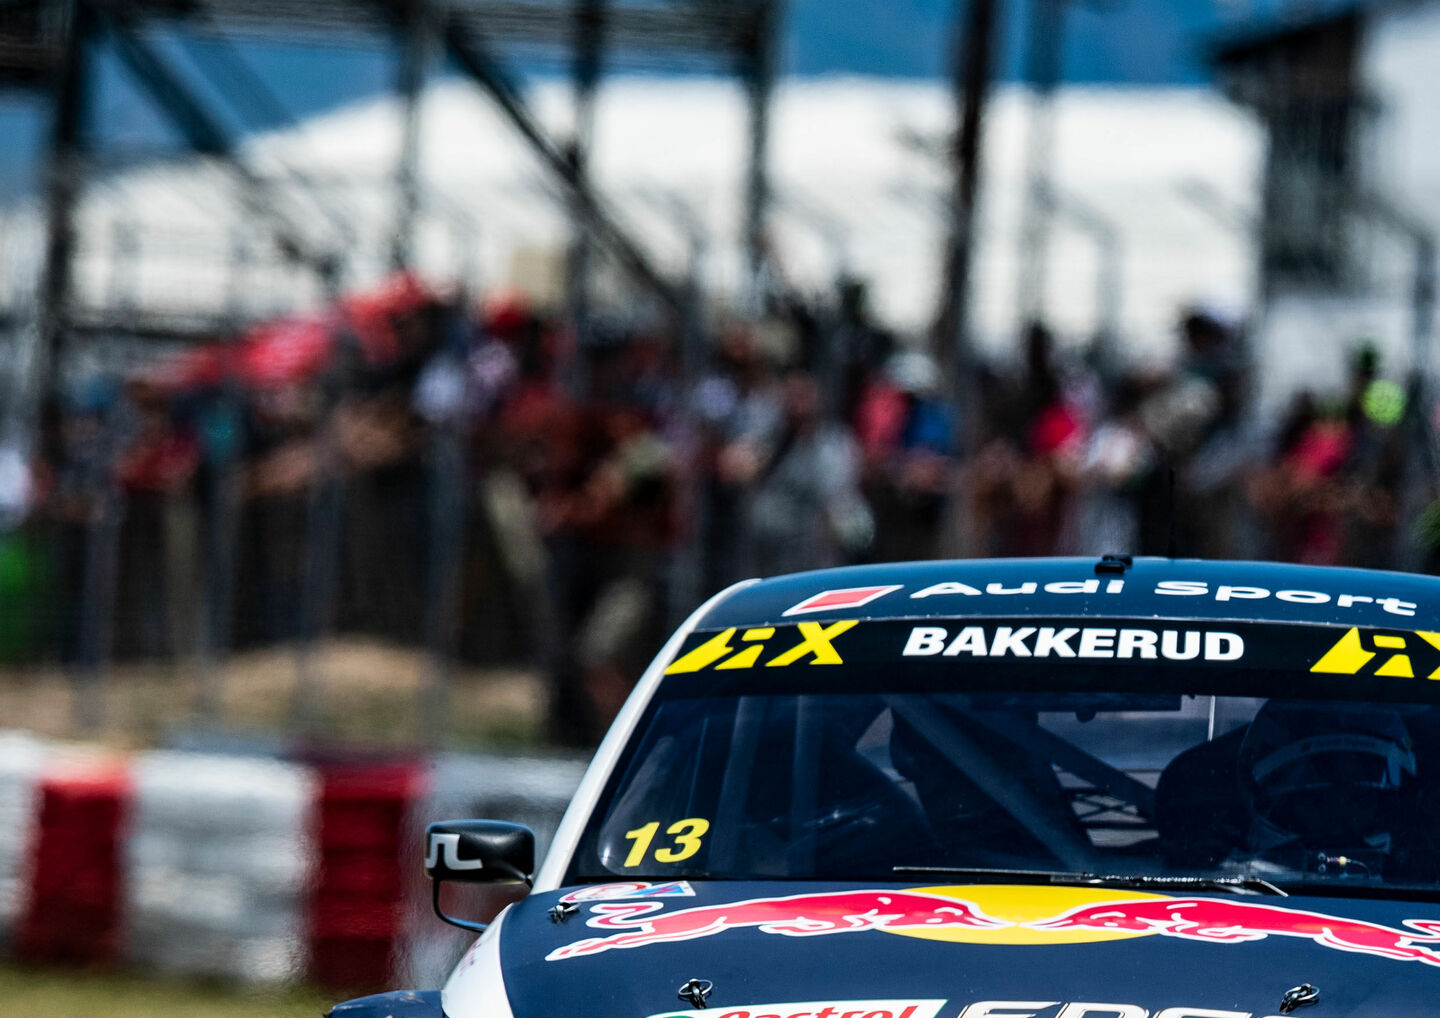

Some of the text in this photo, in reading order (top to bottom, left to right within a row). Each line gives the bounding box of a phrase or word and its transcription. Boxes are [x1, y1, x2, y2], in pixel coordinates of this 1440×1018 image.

[910, 579, 1418, 616] Audi Sport
[903, 627, 1244, 661] BAKKERUD
[624, 818, 709, 867] 13
